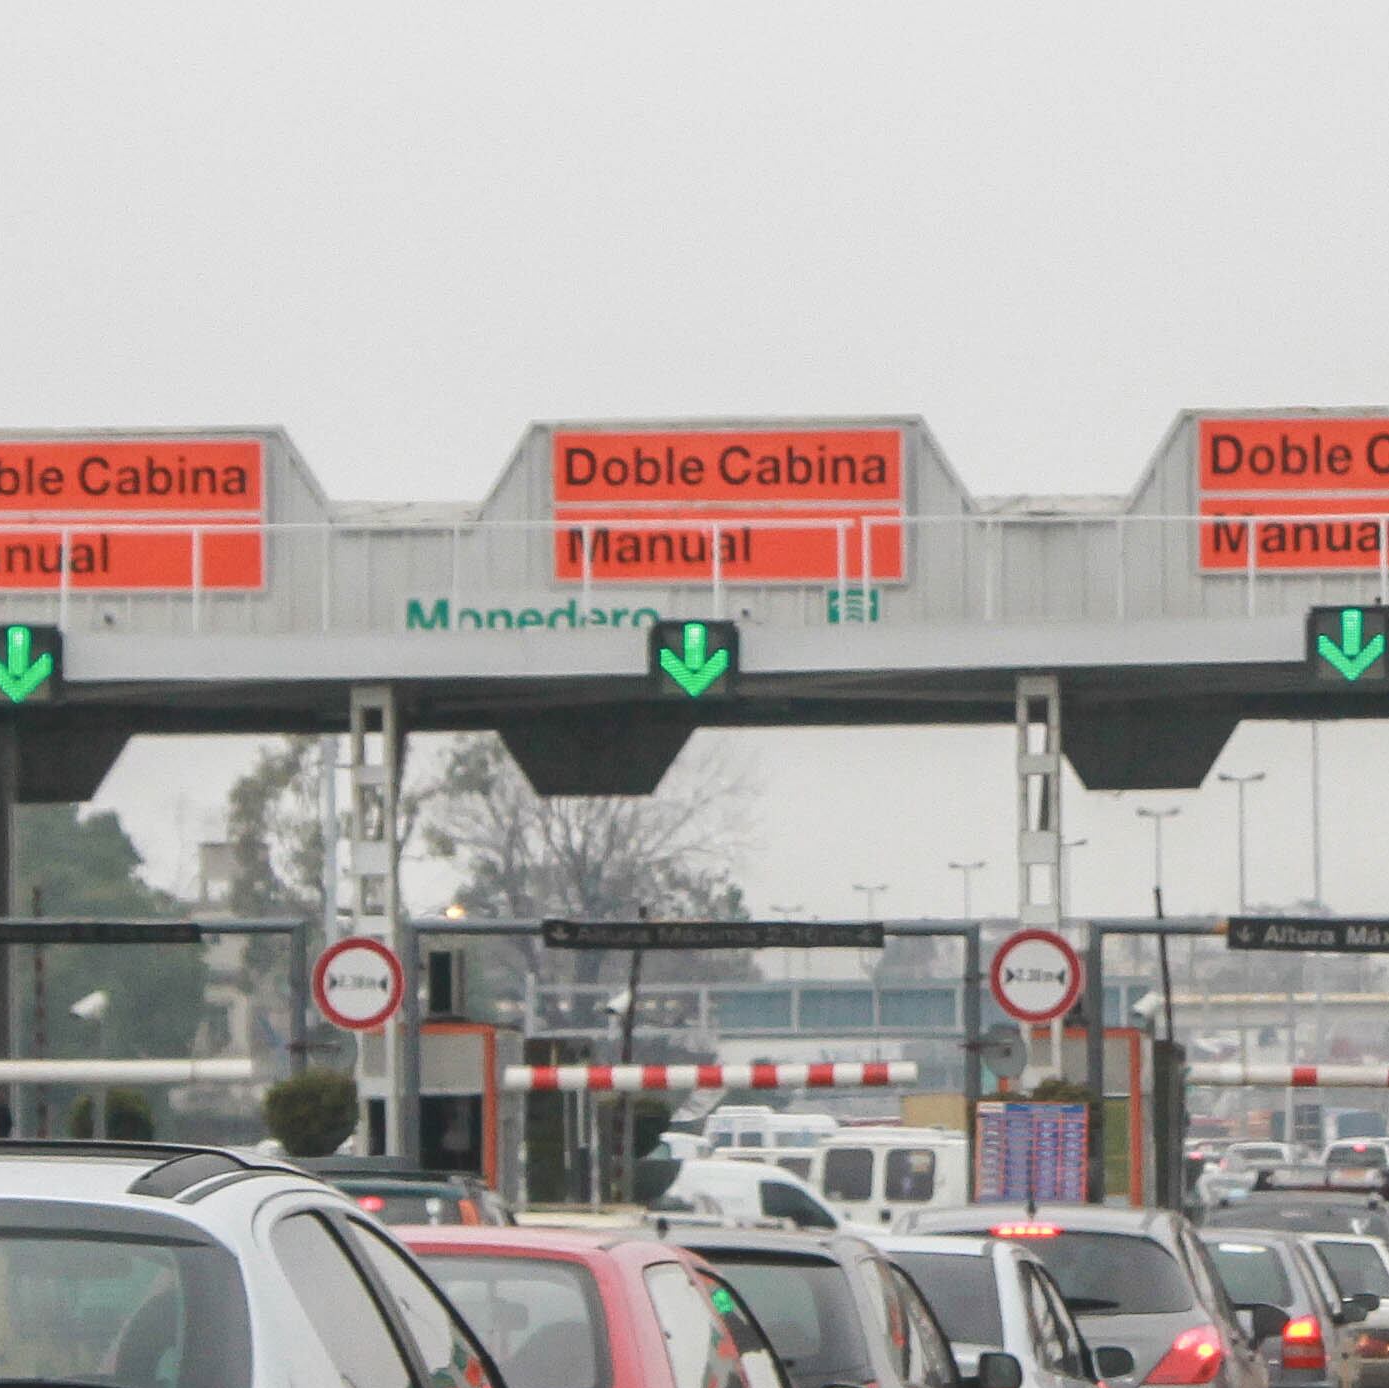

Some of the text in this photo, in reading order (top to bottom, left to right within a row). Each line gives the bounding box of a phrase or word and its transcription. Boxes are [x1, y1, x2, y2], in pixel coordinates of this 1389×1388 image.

[564, 445, 888, 487] Doble Cabina
[1211, 434, 1353, 475] Doble
[78, 456, 248, 497] Cabina
[567, 526, 753, 564] Manual
[1264, 924, 1337, 946] Altura
